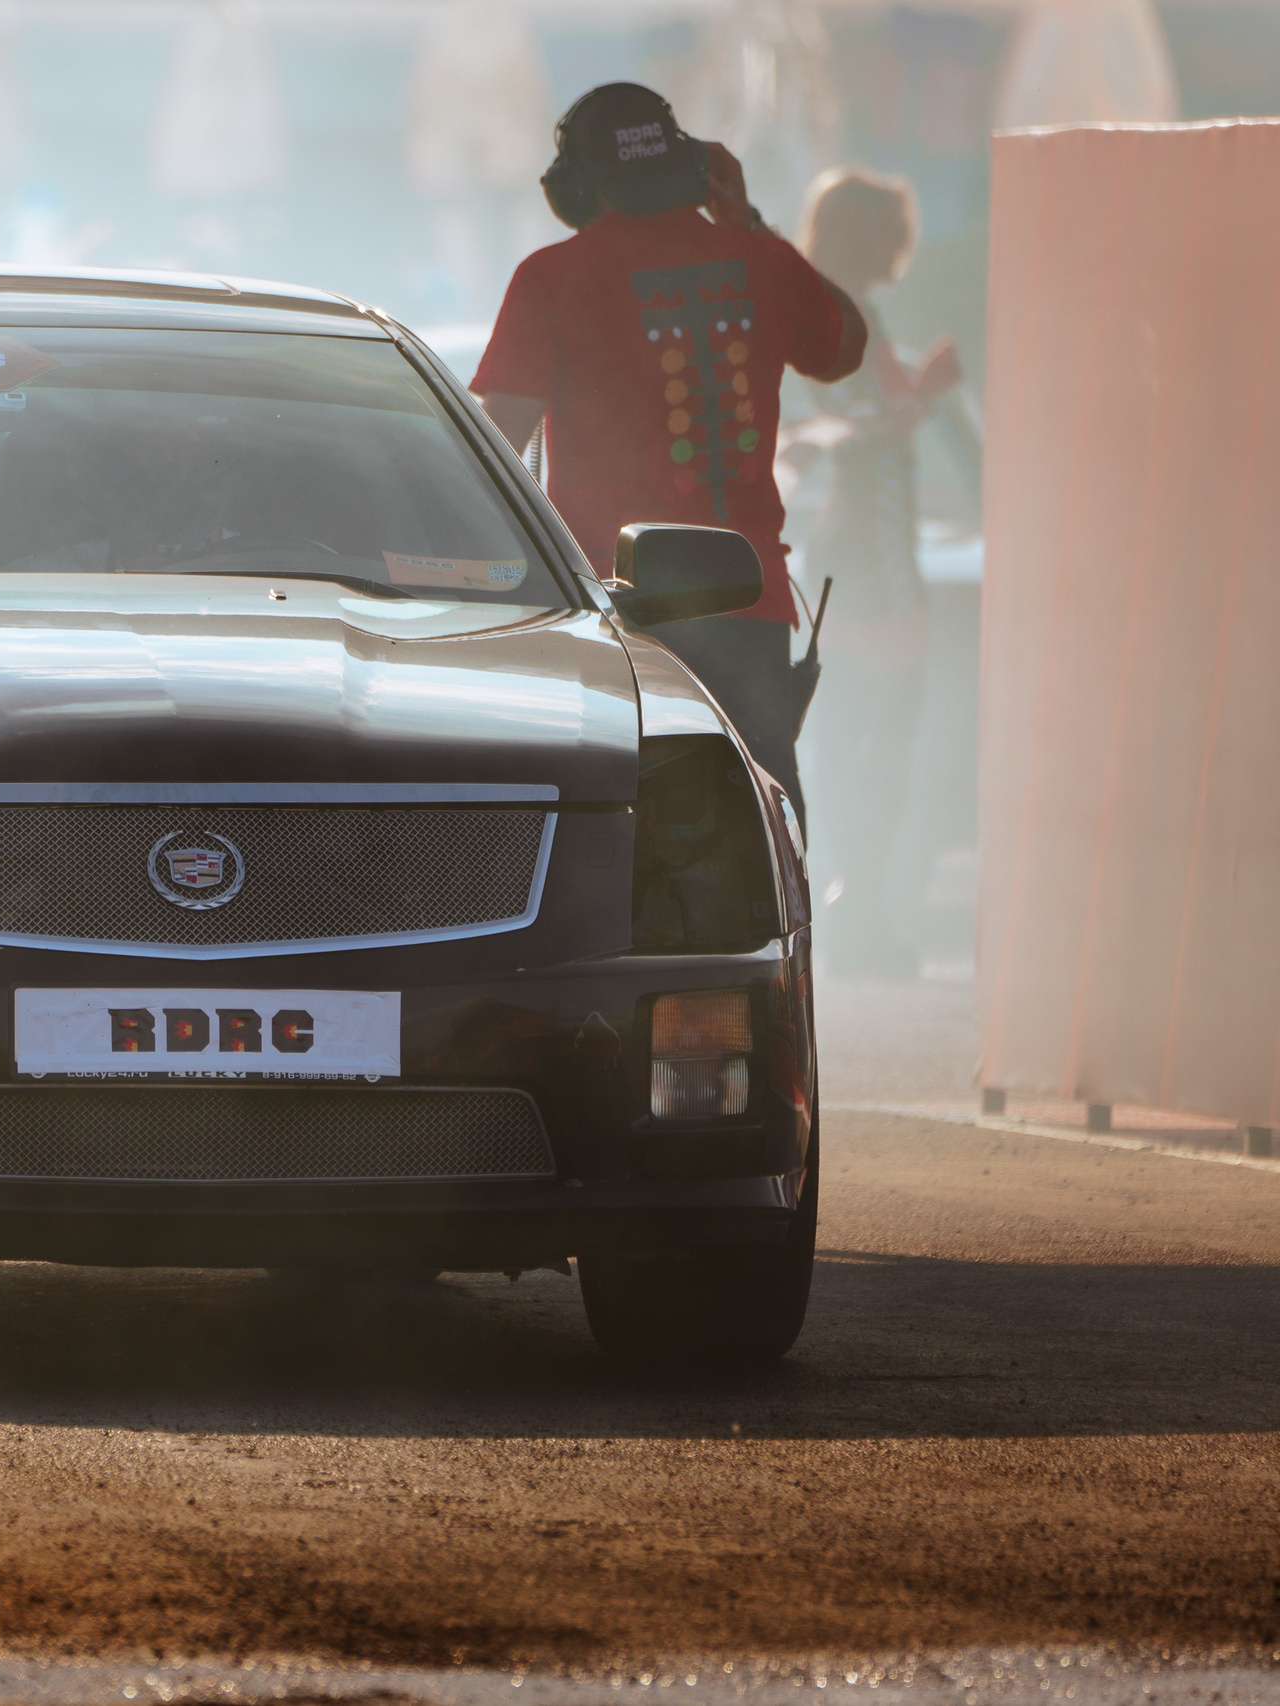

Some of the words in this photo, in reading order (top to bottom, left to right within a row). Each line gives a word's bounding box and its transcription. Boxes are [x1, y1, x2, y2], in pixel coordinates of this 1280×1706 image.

[616, 122, 663, 144] RDRC
[619, 139, 668, 162] Official
[108, 1008, 315, 1053] RDRC
